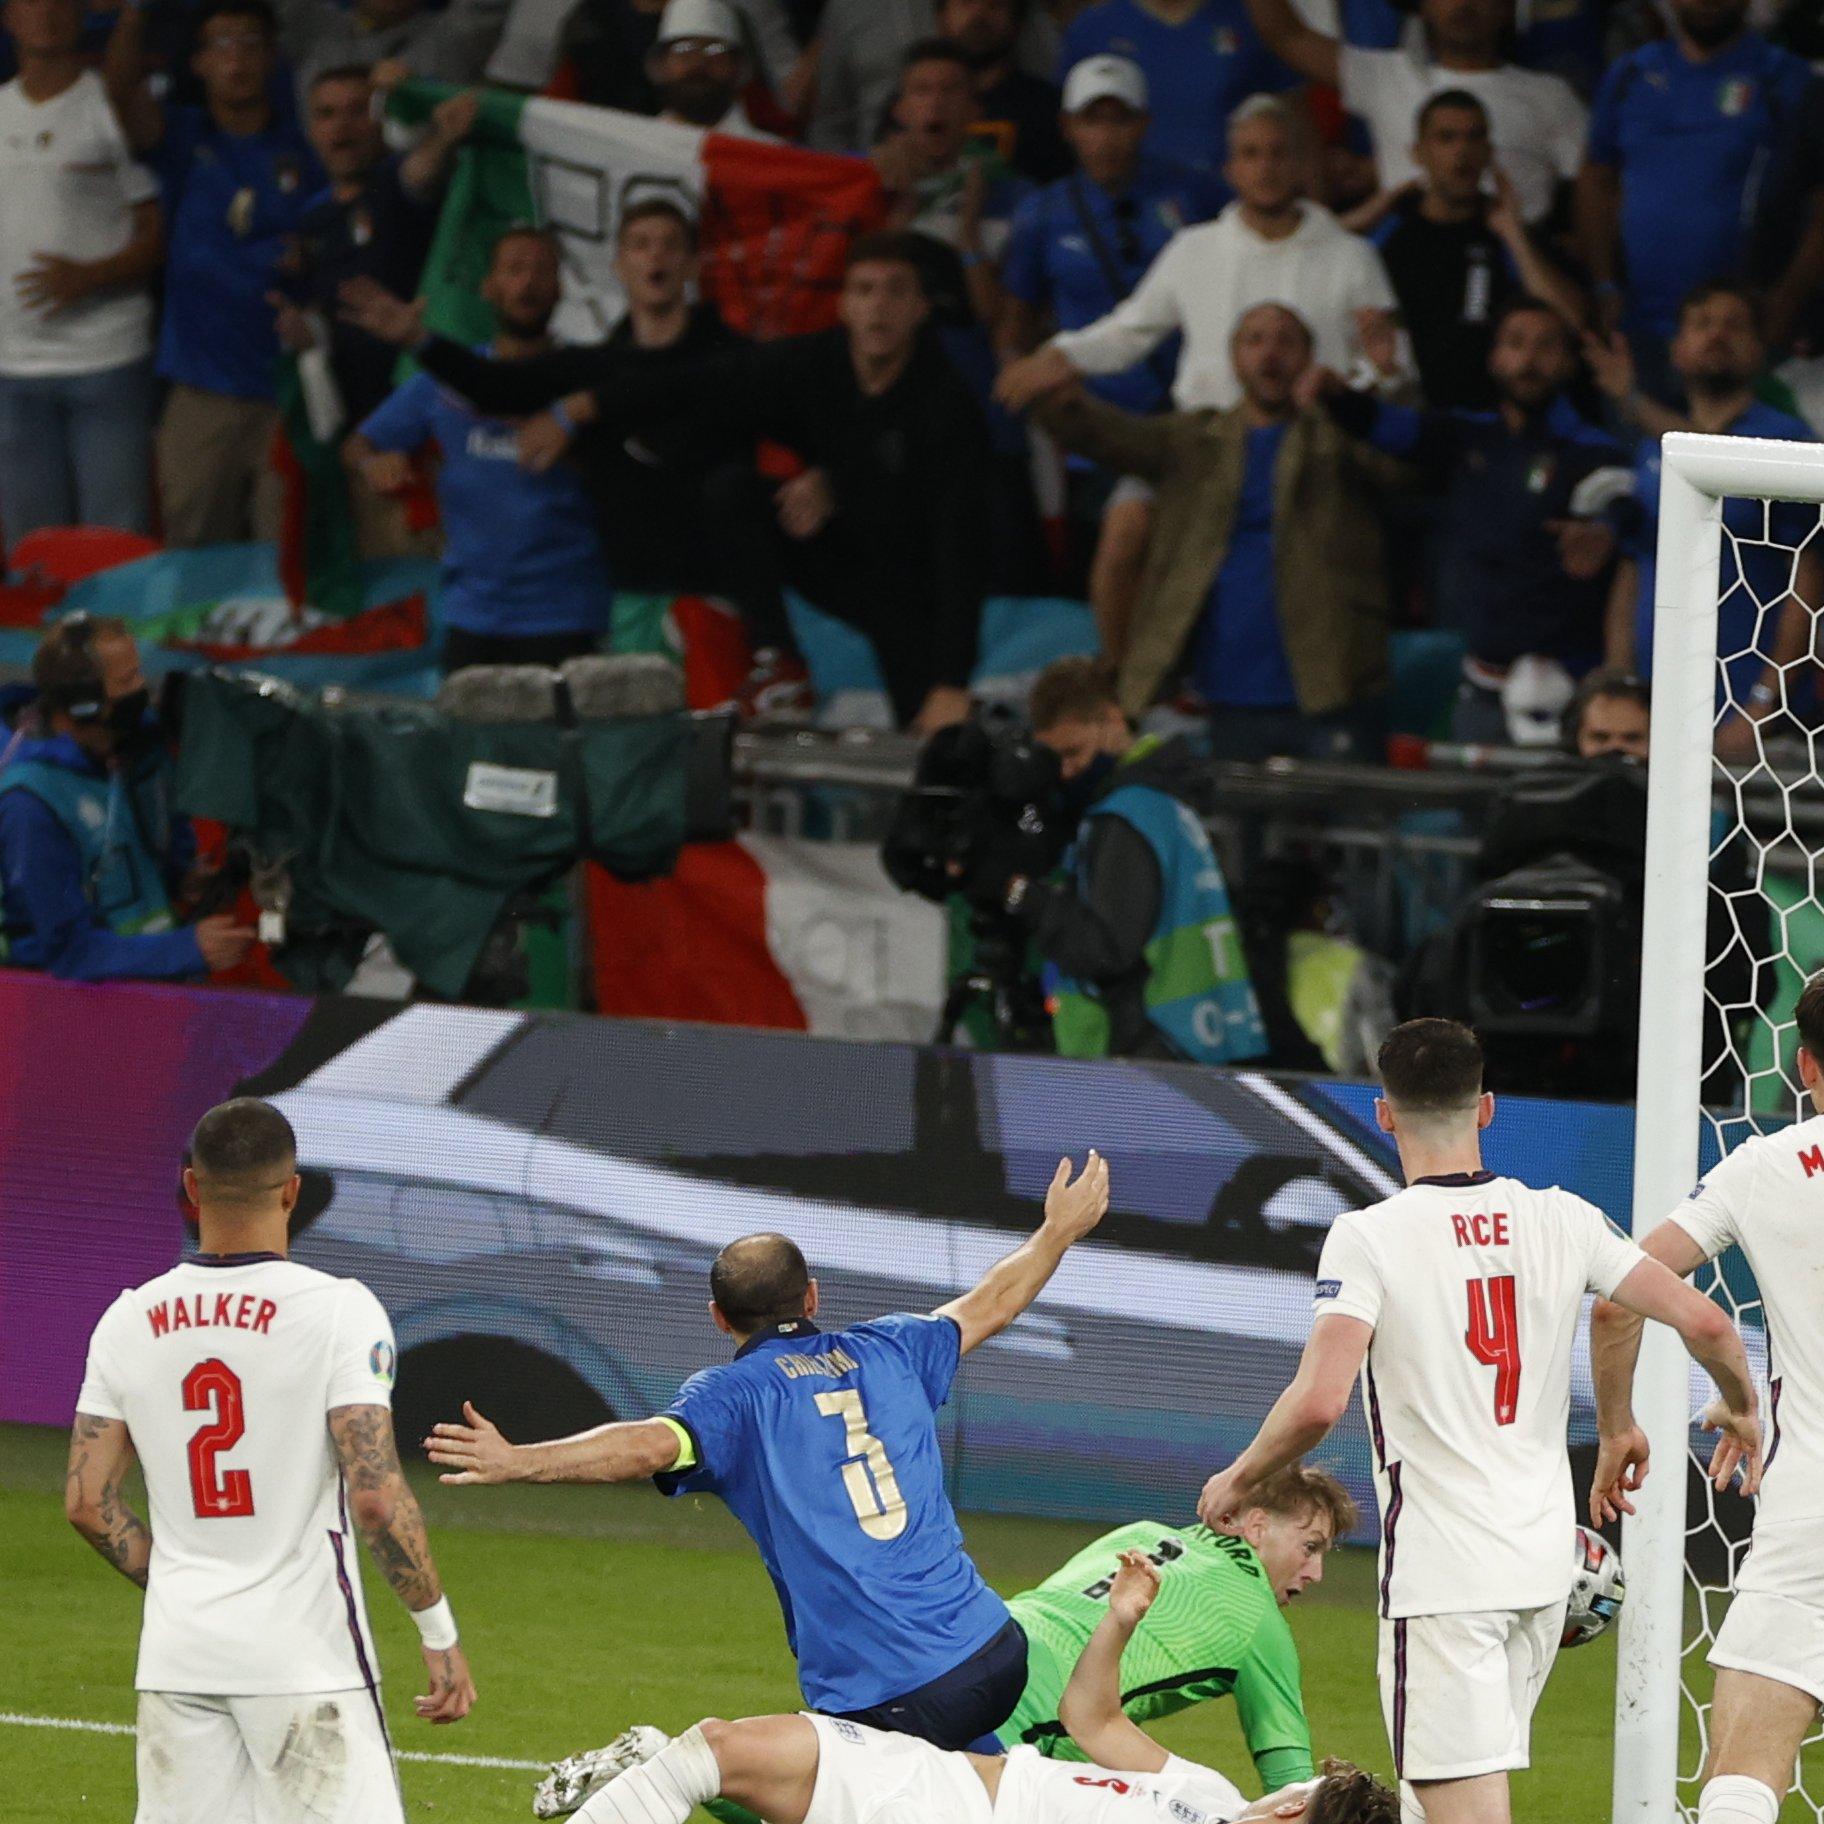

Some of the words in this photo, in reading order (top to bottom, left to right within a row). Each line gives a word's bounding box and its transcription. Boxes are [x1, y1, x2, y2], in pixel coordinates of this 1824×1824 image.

[146, 1292, 278, 1339] WALKER
[1465, 1275, 1522, 1426] 4
[181, 1357, 256, 1518] 2
[813, 1388, 908, 1541] 3
